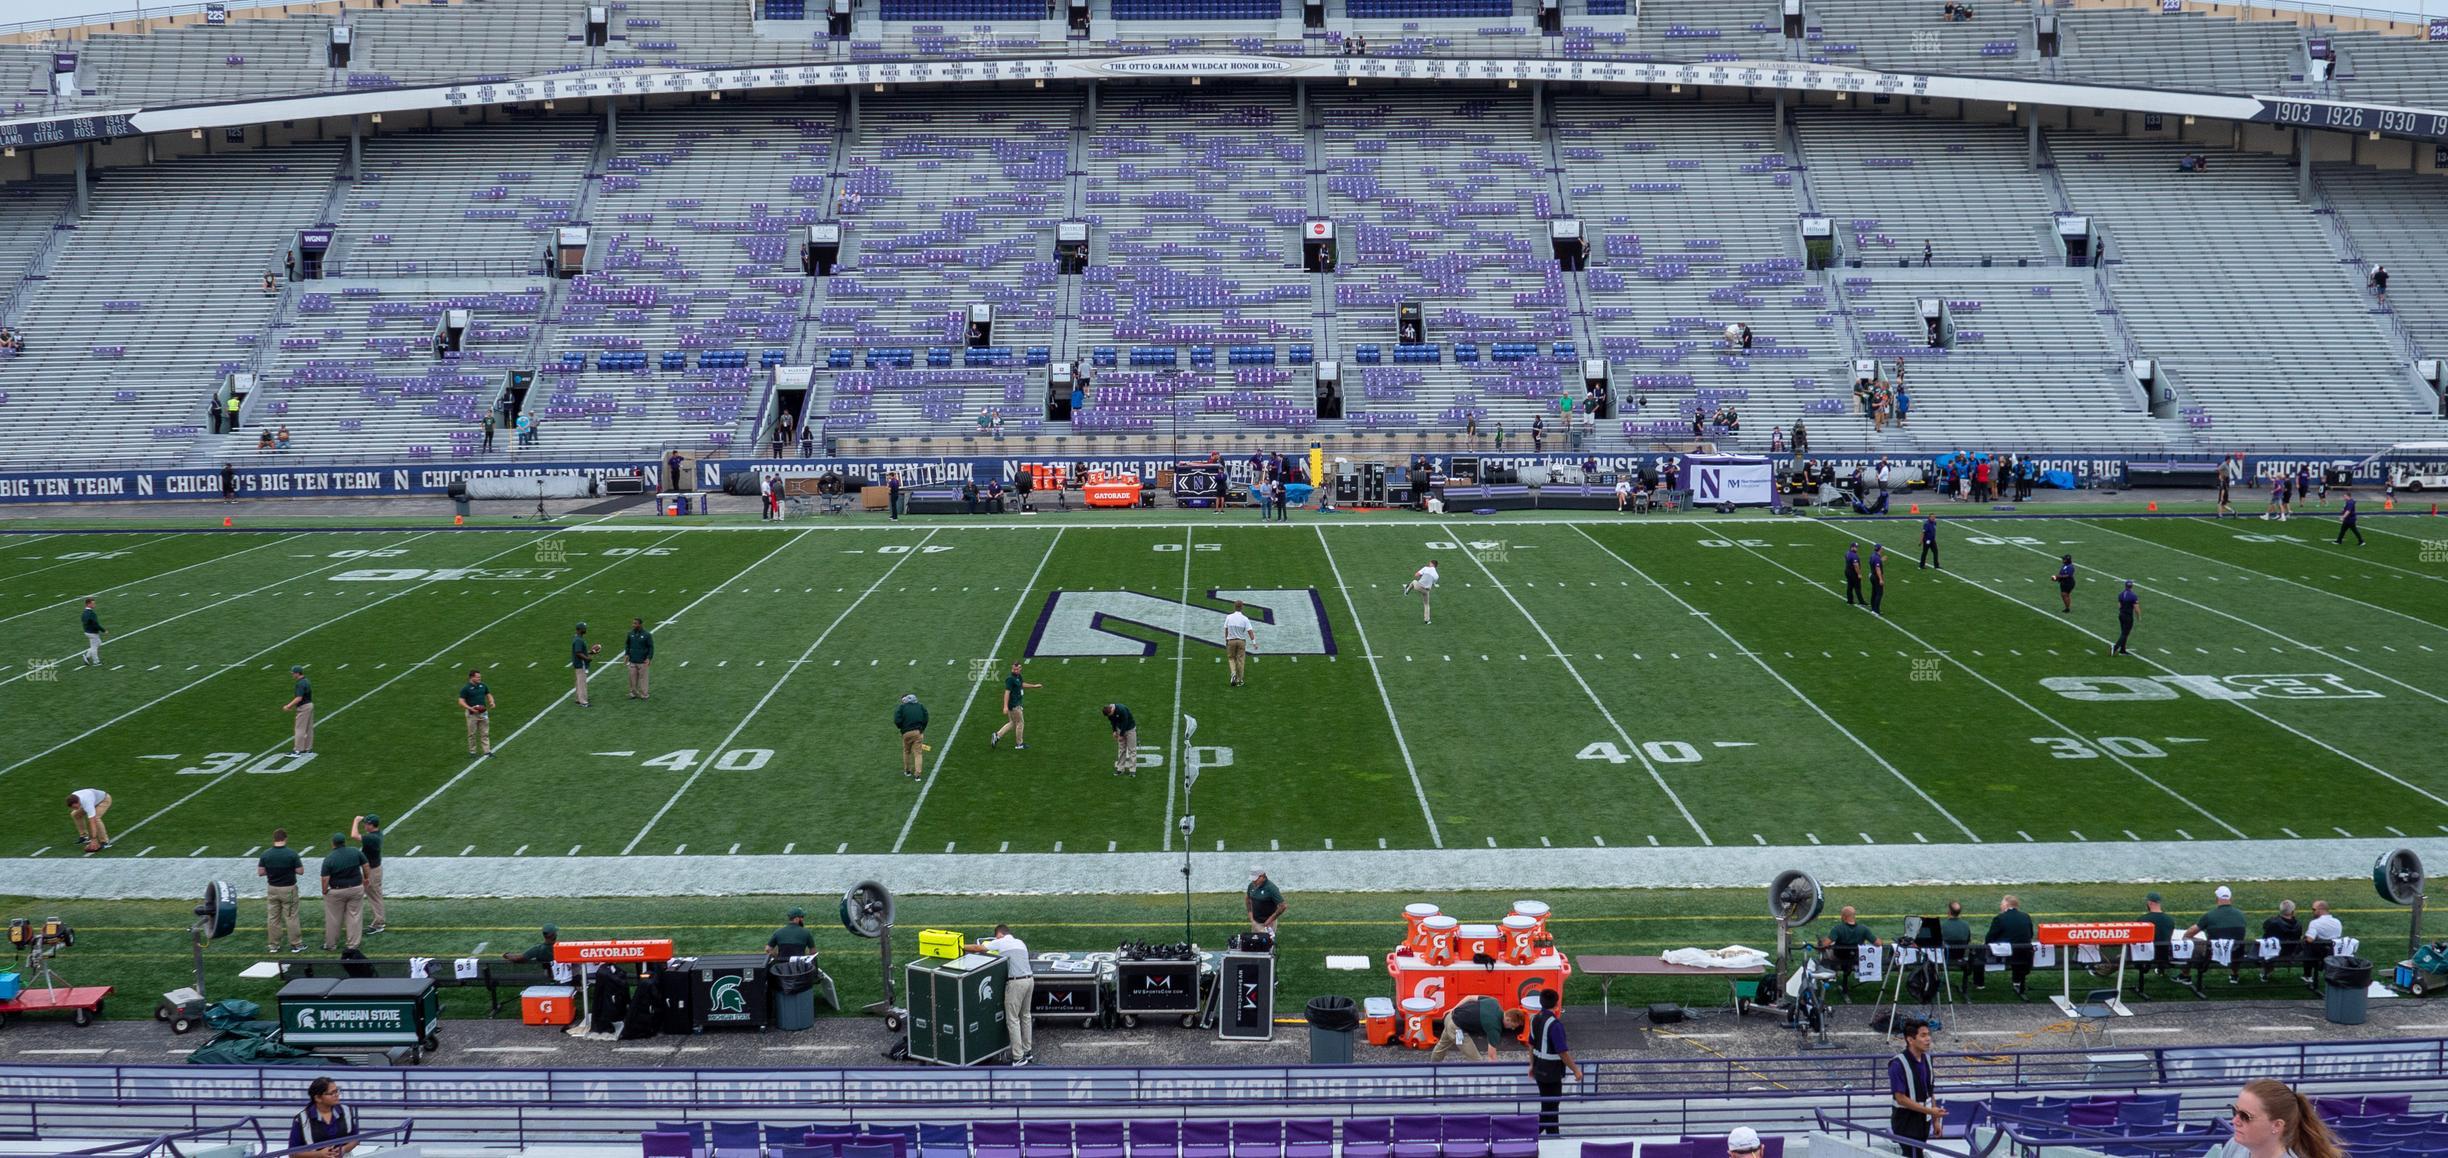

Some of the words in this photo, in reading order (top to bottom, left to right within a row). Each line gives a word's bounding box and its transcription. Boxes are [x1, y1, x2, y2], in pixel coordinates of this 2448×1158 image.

[208, 11, 224, 20] 225
[2431, 26, 2448, 35] 234
[73, 119, 93, 128] 1996
[105, 115, 125, 125] 1949
[2147, 115, 2160, 124] 133
[2275, 103, 2311, 122] 1903
[2326, 107, 2364, 126] 1926
[2378, 111, 2416, 131] 1930
[37, 122, 56, 131] 1997
[74, 127, 96, 138] ROSE
[106, 125, 128, 135] ROSE
[33, 130, 64, 142] CITRUS
[2437, 152, 2448, 162] 13
[704, 463, 720, 485] N
[1003, 460, 1018, 482] N
[2091, 461, 2121, 477] BIG
[261, 473, 289, 490] BIG
[293, 472, 325, 490] TEN
[329, 471, 381, 489] TEAM
[394, 470, 409, 490] N
[1193, 475, 1204, 490] N
[1701, 468, 1720, 499] N
[2339, 473, 2346, 482] N
[0, 479, 29, 498] BIG
[33, 479, 70, 496] TEN
[74, 477, 124, 496] TEAM
[137, 475, 153, 496] N
[877, 545, 955, 554] 40
[1152, 543, 1222, 552] 50
[1025, 589, 1337, 657] N
[1575, 741, 1703, 764] 40
[2030, 737, 2168, 759] 30
[641, 749, 775, 771] 40
[1136, 746, 1233, 767] 50
[175, 752, 319, 775] 30
[1515, 934, 1528, 947] G
[2068, 929, 2130, 939] GATORADE
[1433, 935, 1445, 948] G
[1472, 941, 1484, 953] G
[580, 947, 645, 958] GATORADE
[1414, 977, 1445, 1009] G
[540, 1001, 553, 1013] G
[320, 1010, 370, 1021] MICHIGAN
[371, 1010, 401, 1021] STATE
[1408, 1017, 1421, 1030] G
